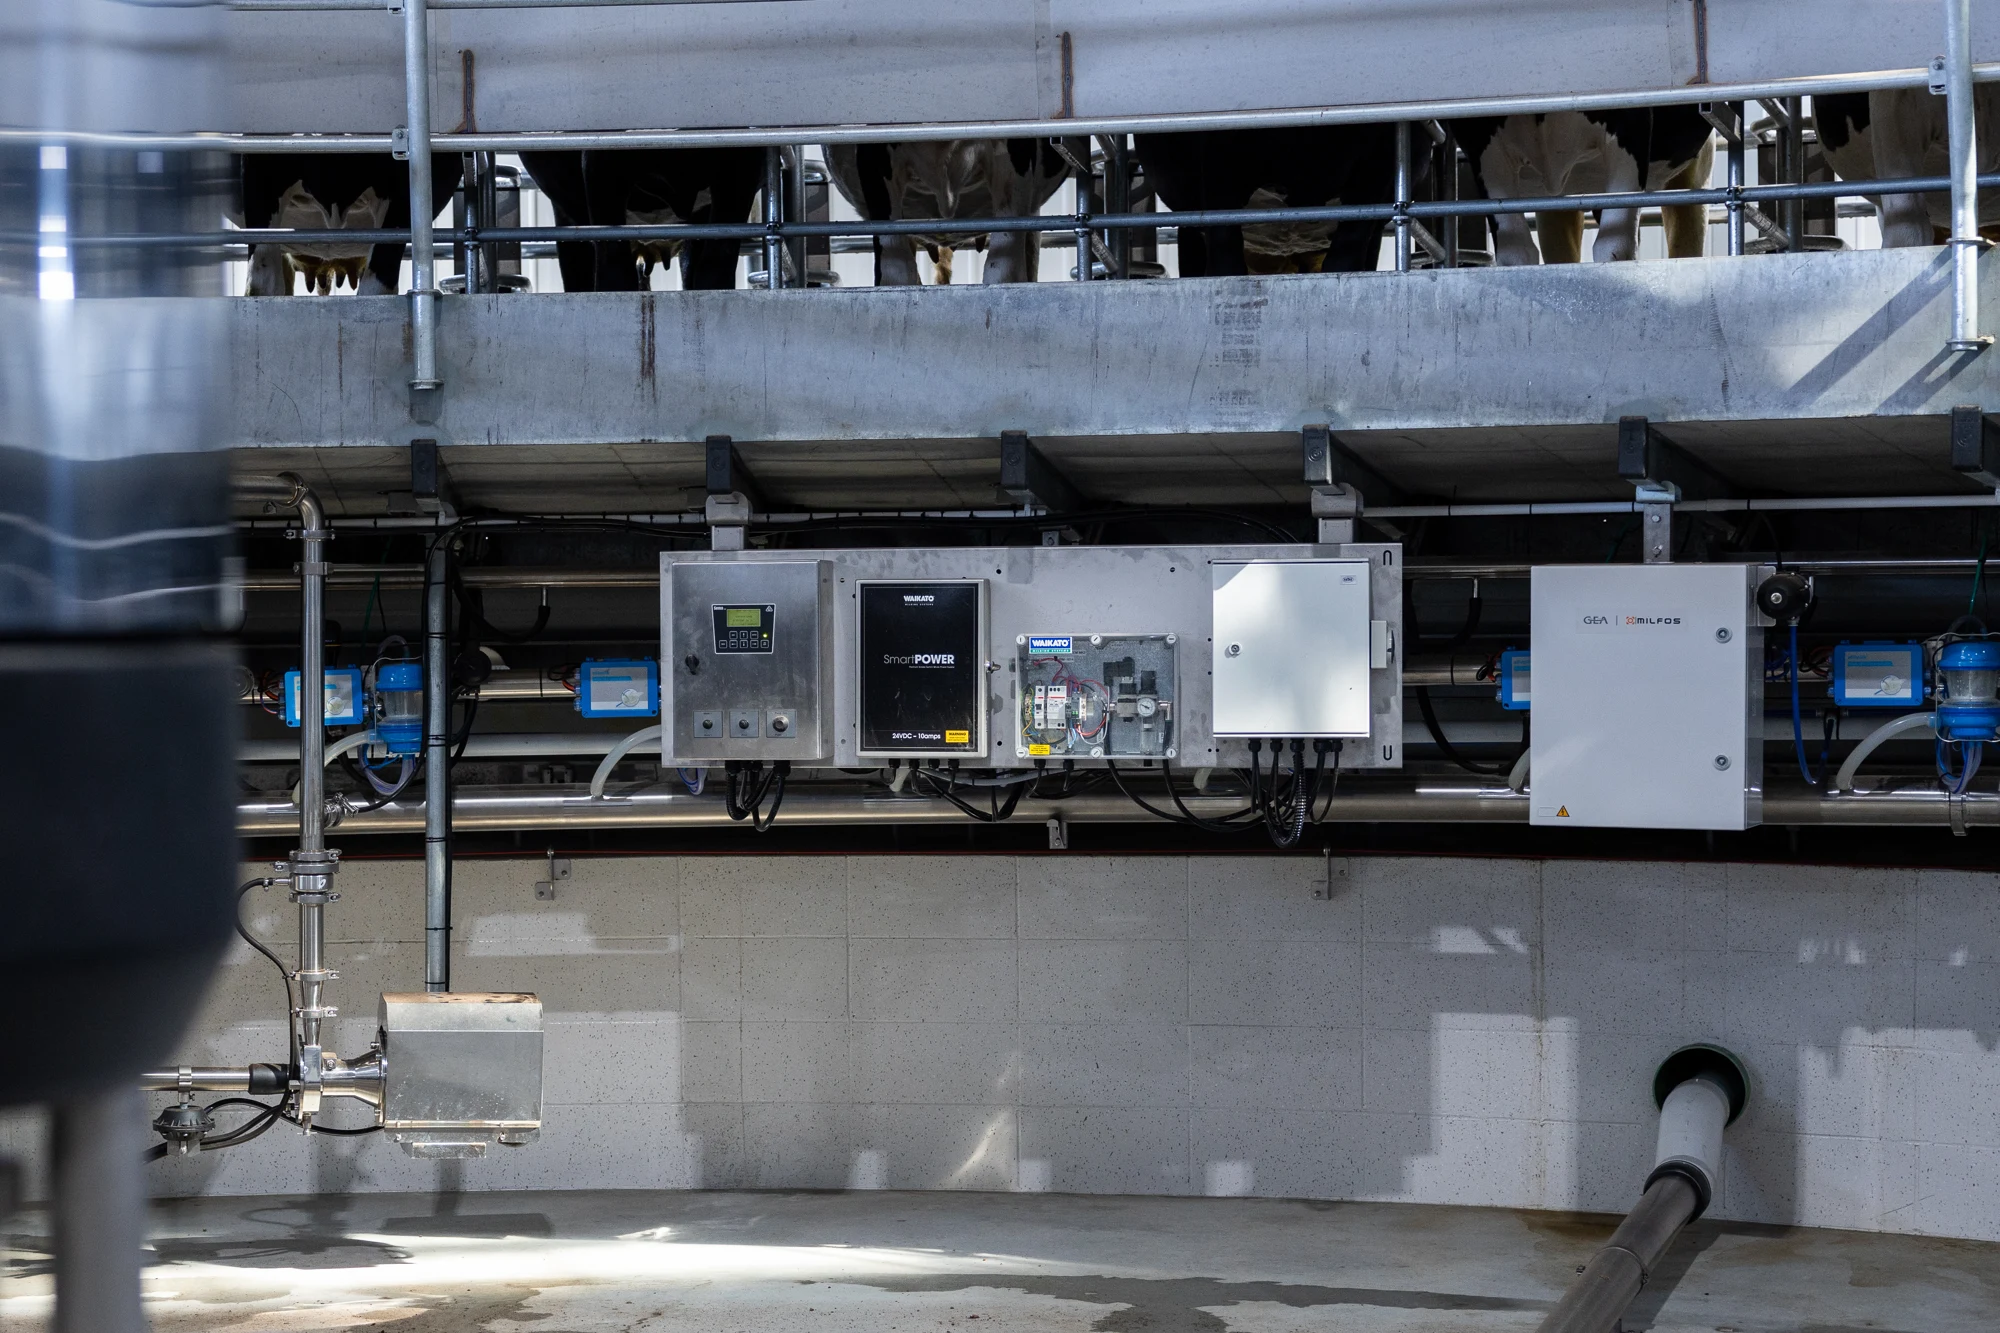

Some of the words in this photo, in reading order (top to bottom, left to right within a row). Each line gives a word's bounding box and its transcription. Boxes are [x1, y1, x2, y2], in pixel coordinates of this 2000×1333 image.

[1583, 616, 1608, 625] GEA
[1637, 617, 1681, 625] MILFOS
[1031, 639, 1069, 647] WAIKATO
[883, 654, 955, 664] SmartPOWER
[918, 732, 941, 740] 10amps
